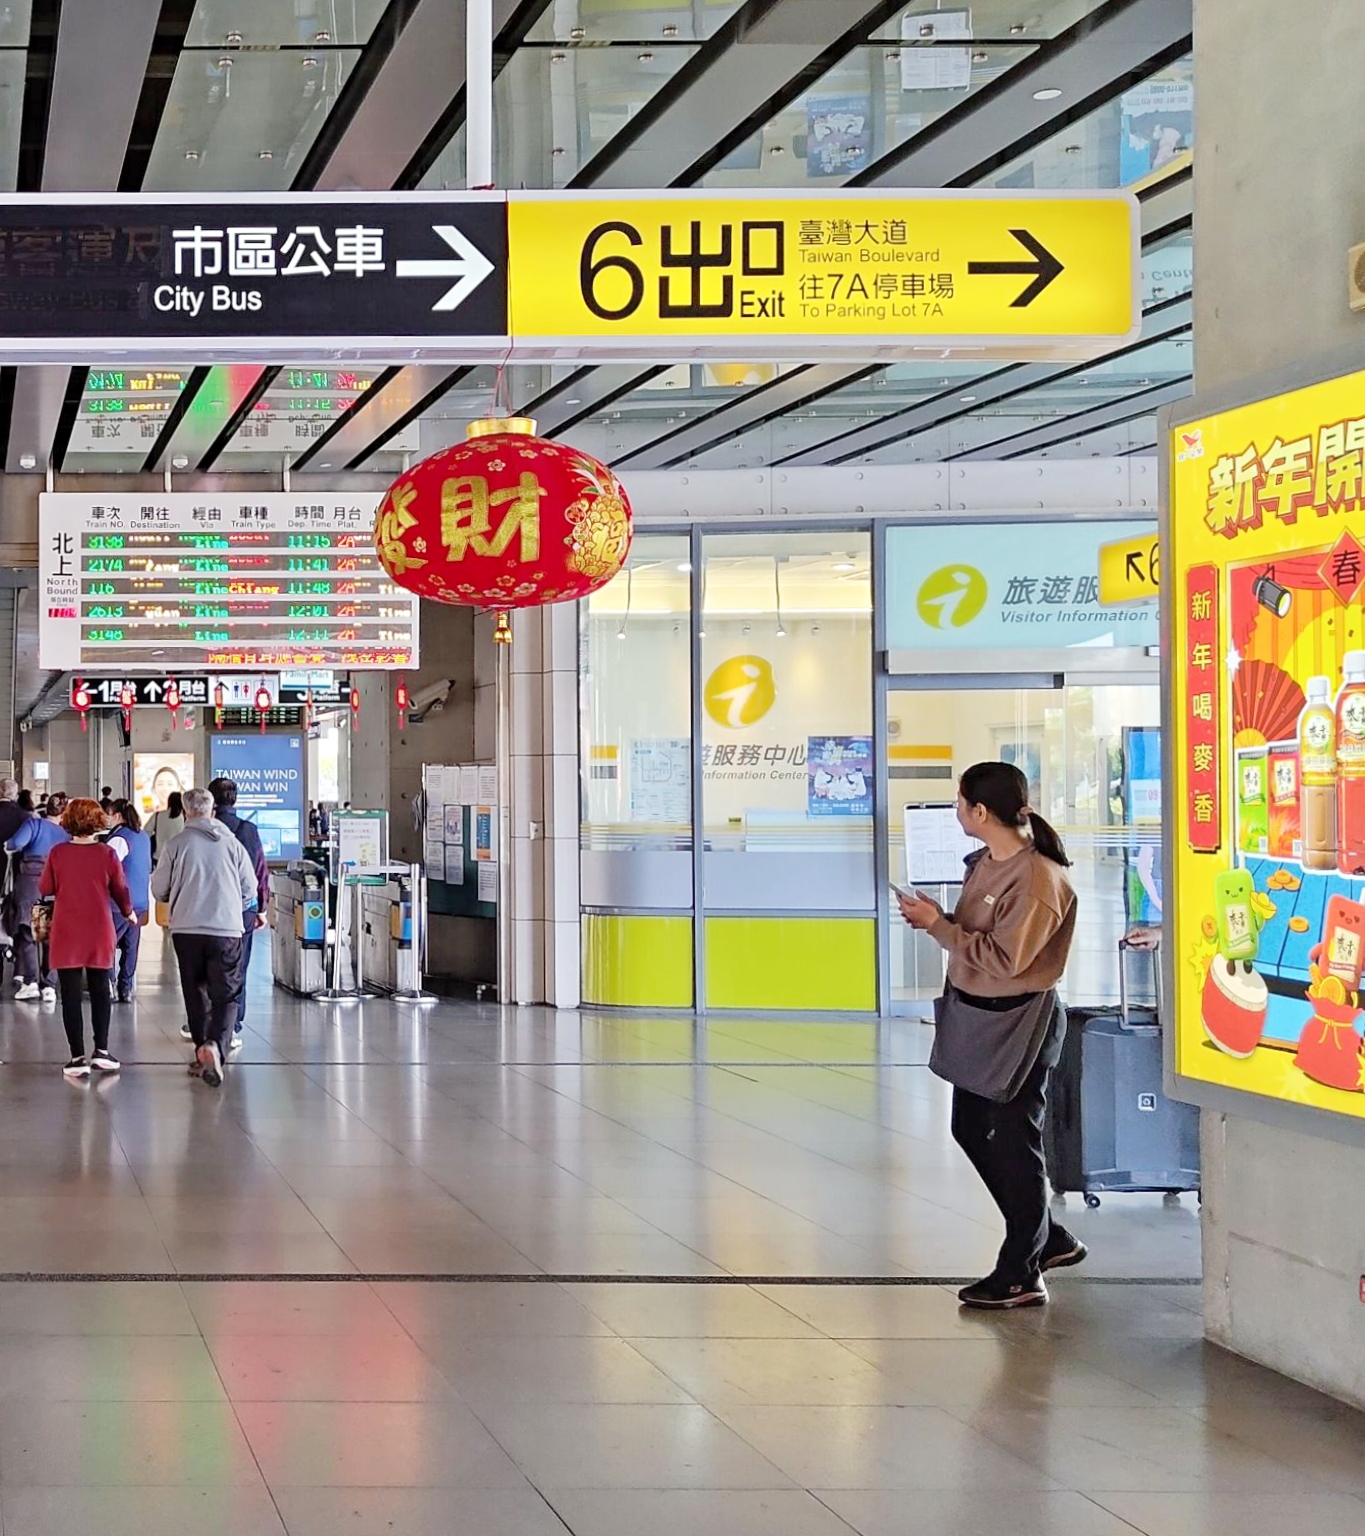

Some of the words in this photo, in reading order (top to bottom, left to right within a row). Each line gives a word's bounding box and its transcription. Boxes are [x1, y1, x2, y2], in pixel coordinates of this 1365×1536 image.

[798, 219, 907, 246] 臺灣大道
[172, 225, 386, 278] 市區公車
[799, 248, 853, 263] Taiwan
[859, 248, 940, 263] Boulevard
[578, 220, 785, 320] 6出口
[798, 273, 954, 300] 往7A停車場
[154, 285, 207, 317] City
[212, 286, 262, 312] Bus
[740, 289, 785, 318] Exit
[799, 303, 821, 317] To
[825, 303, 886, 321] Parking
[891, 303, 917, 317] Lot
[922, 303, 944, 317] 7A
[91, 506, 121, 520] 車次
[140, 506, 170, 521] 開往
[192, 507, 222, 521] 經由
[238, 506, 269, 521] 車種
[294, 506, 325, 520] 時間
[333, 506, 362, 521] 月台
[85, 520, 108, 529] Train
[130, 521, 181, 529] Destination
[199, 521, 214, 529] Via
[231, 521, 254, 529] Train
[255, 521, 276, 530] Type
[288, 520, 308, 529] Dep.
[311, 520, 332, 529] Time
[337, 521, 357, 529] Plat.
[287, 535, 331, 548] 11:15
[52, 532, 74, 576] 北上
[287, 558, 331, 572] 11:41
[1332, 549, 1362, 587] 春
[46, 578, 78, 586] North
[46, 587, 78, 595] Bound
[1001, 610, 1052, 623] Visitor
[1057, 609, 1148, 623] Information
[1191, 591, 1215, 824] 新年喝麥香
[216, 769, 261, 780] TAIWAN
[263, 769, 298, 780] WIND
[770, 770, 808, 780] Center
[263, 782, 289, 792] WIN
